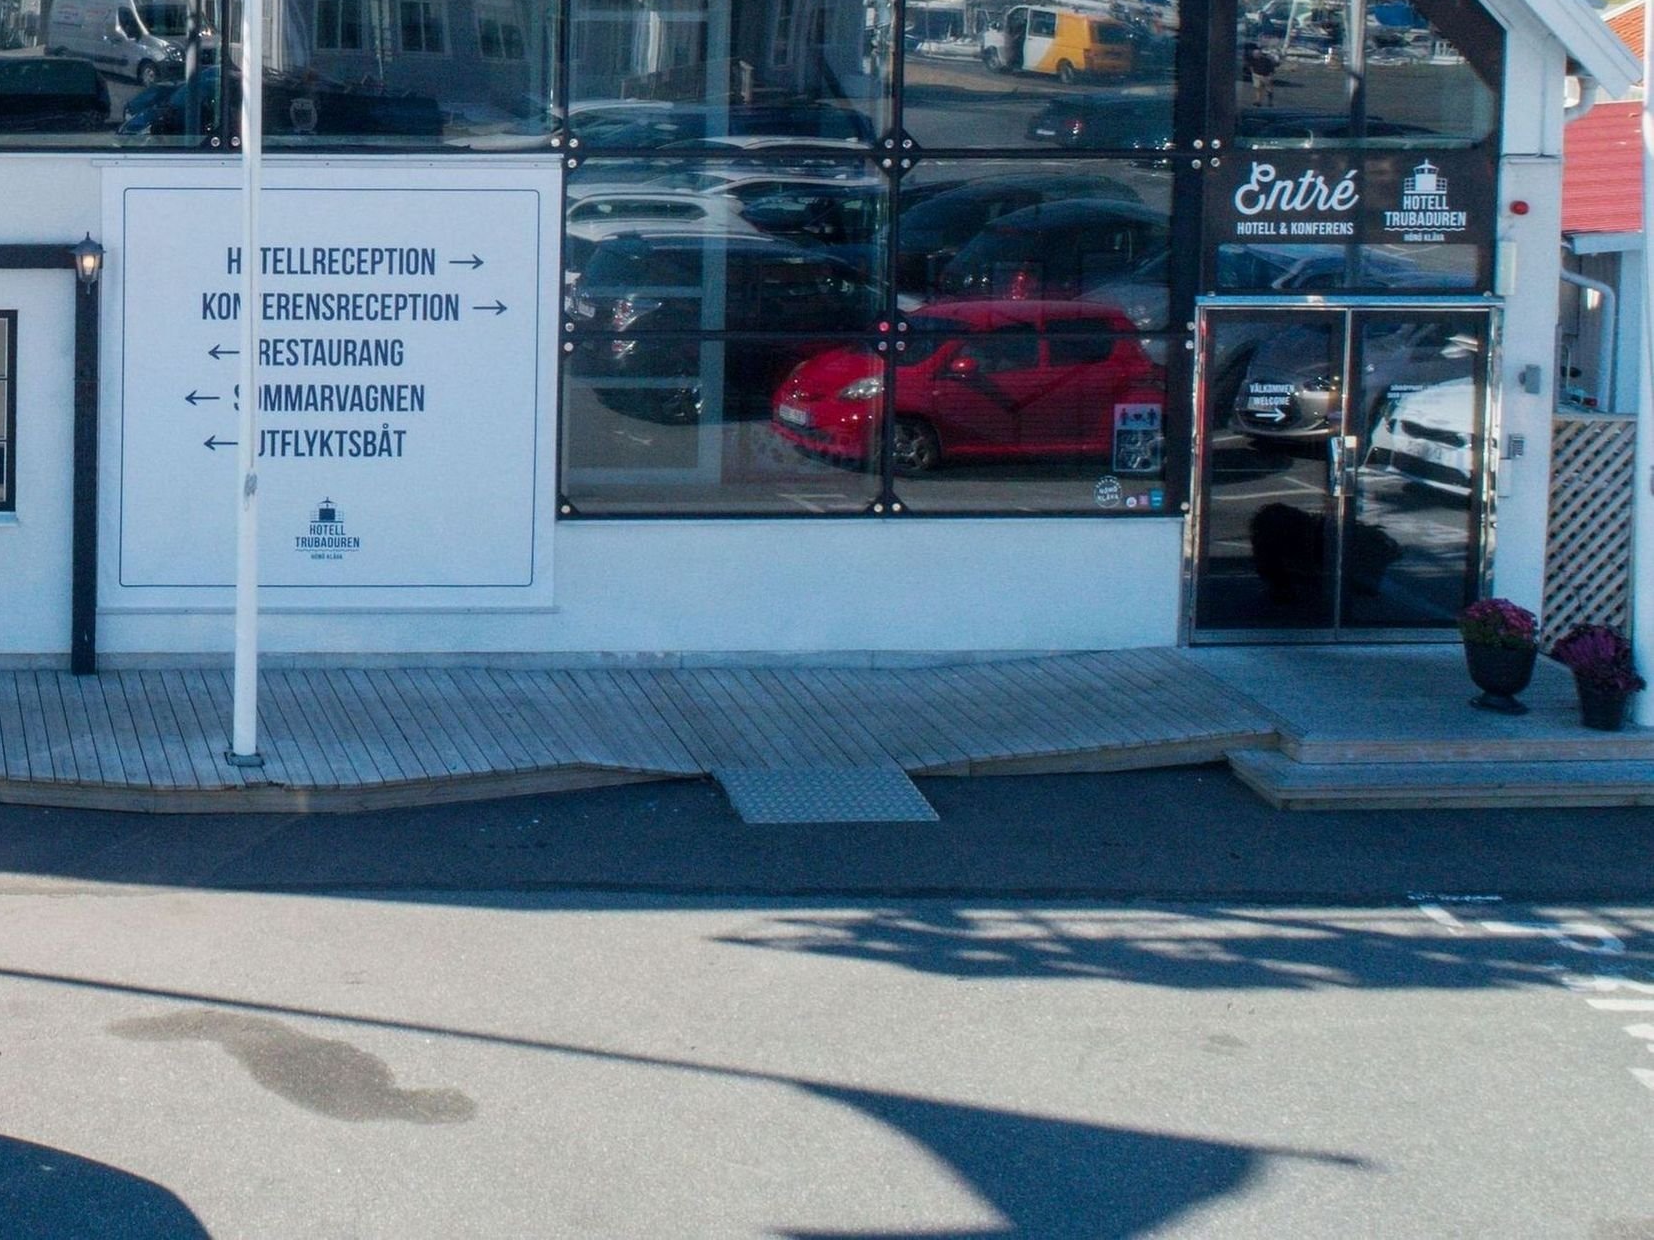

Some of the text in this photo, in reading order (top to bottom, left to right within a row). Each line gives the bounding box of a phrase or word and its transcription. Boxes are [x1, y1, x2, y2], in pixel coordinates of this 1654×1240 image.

[1235, 162, 1360, 215] Entré
[1403, 195, 1449, 210] HOTELL
[1384, 211, 1466, 226] TRUBADUREN
[1237, 222, 1354, 235] HOTELL & KONFERENS
[227, 247, 435, 275] HTELLRECEPTION
[202, 292, 459, 321] KONERENSRECEPTION
[258, 339, 404, 366] RESTAURANG
[309, 524, 346, 535] HOTELL
[295, 537, 360, 548] TRUBADUREN
